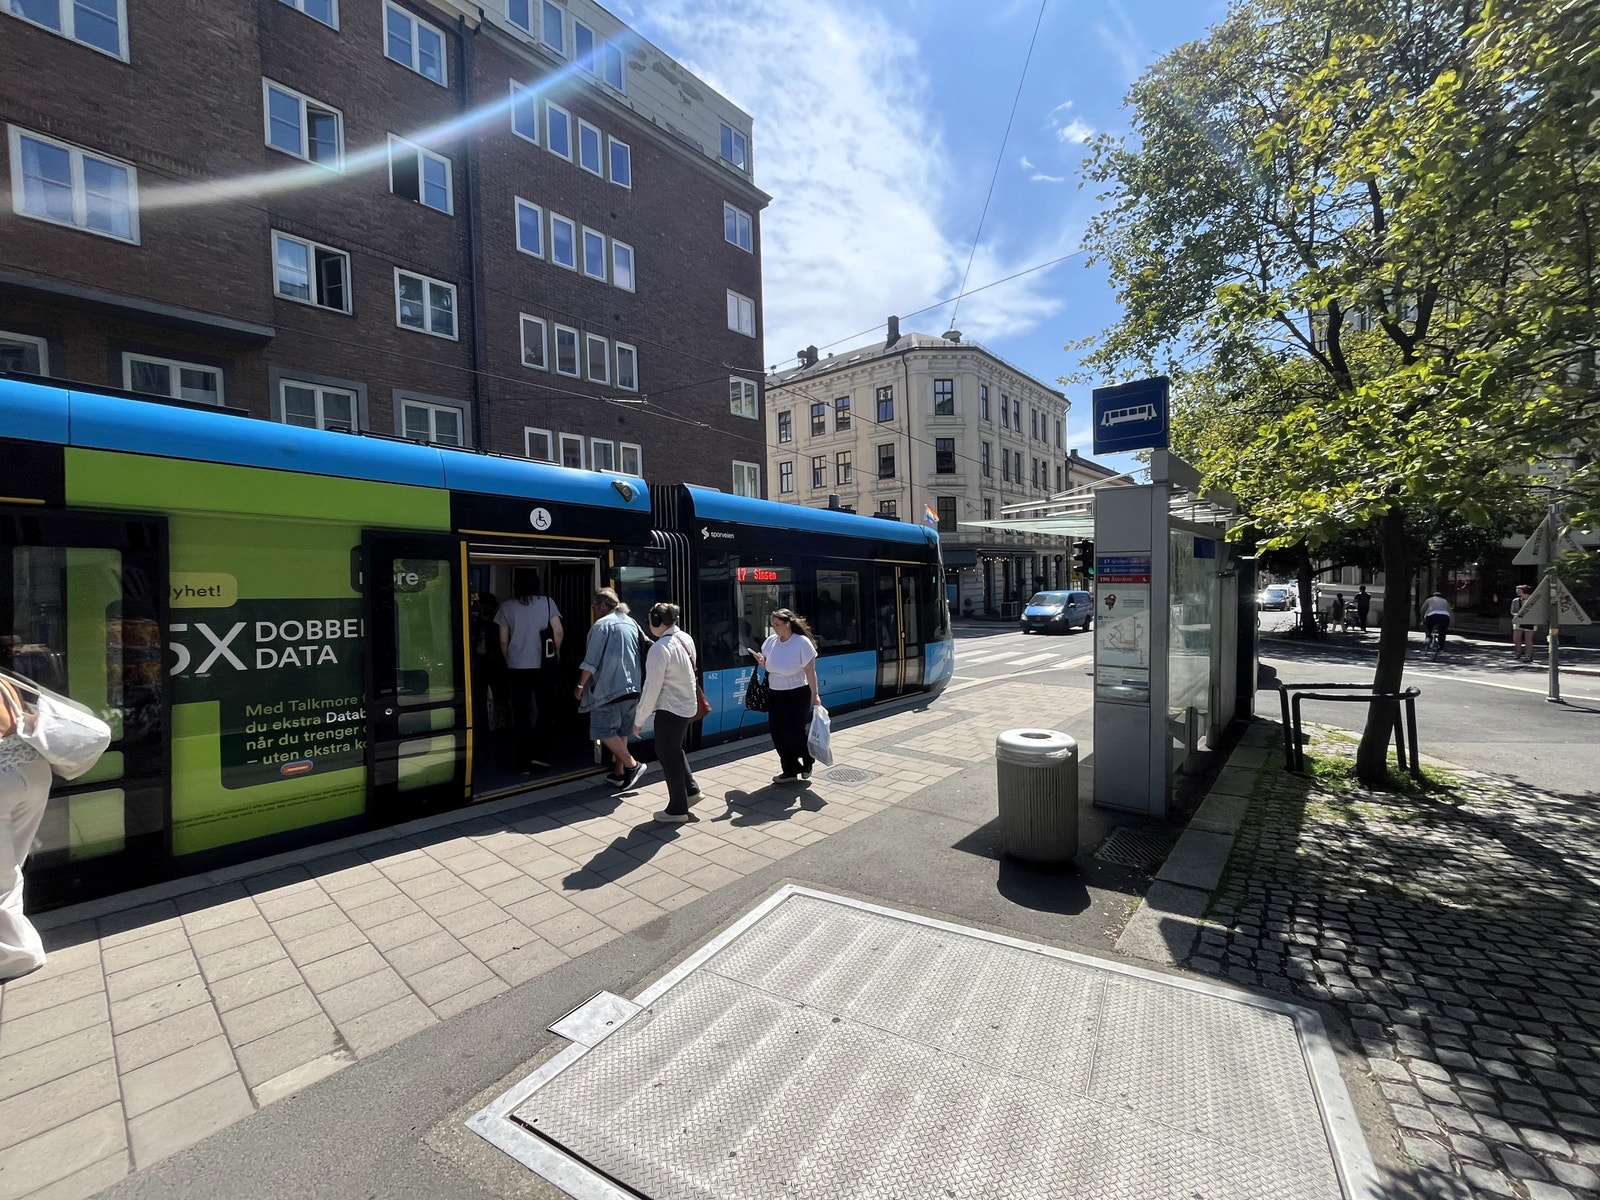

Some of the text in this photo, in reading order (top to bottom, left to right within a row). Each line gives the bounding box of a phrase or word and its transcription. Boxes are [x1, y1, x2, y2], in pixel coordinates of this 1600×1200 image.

[710, 530, 735, 539] sporveien
[256, 644, 339, 670] DATA
[245, 701, 284, 716] Med
[288, 696, 358, 711] Talkmore
[245, 721, 267, 733] du
[272, 716, 321, 730] ekstra
[246, 736, 273, 750] når
[278, 733, 299, 745] du
[303, 726, 359, 742] trenger
[262, 751, 299, 764] uten
[304, 742, 350, 758] ekstra
